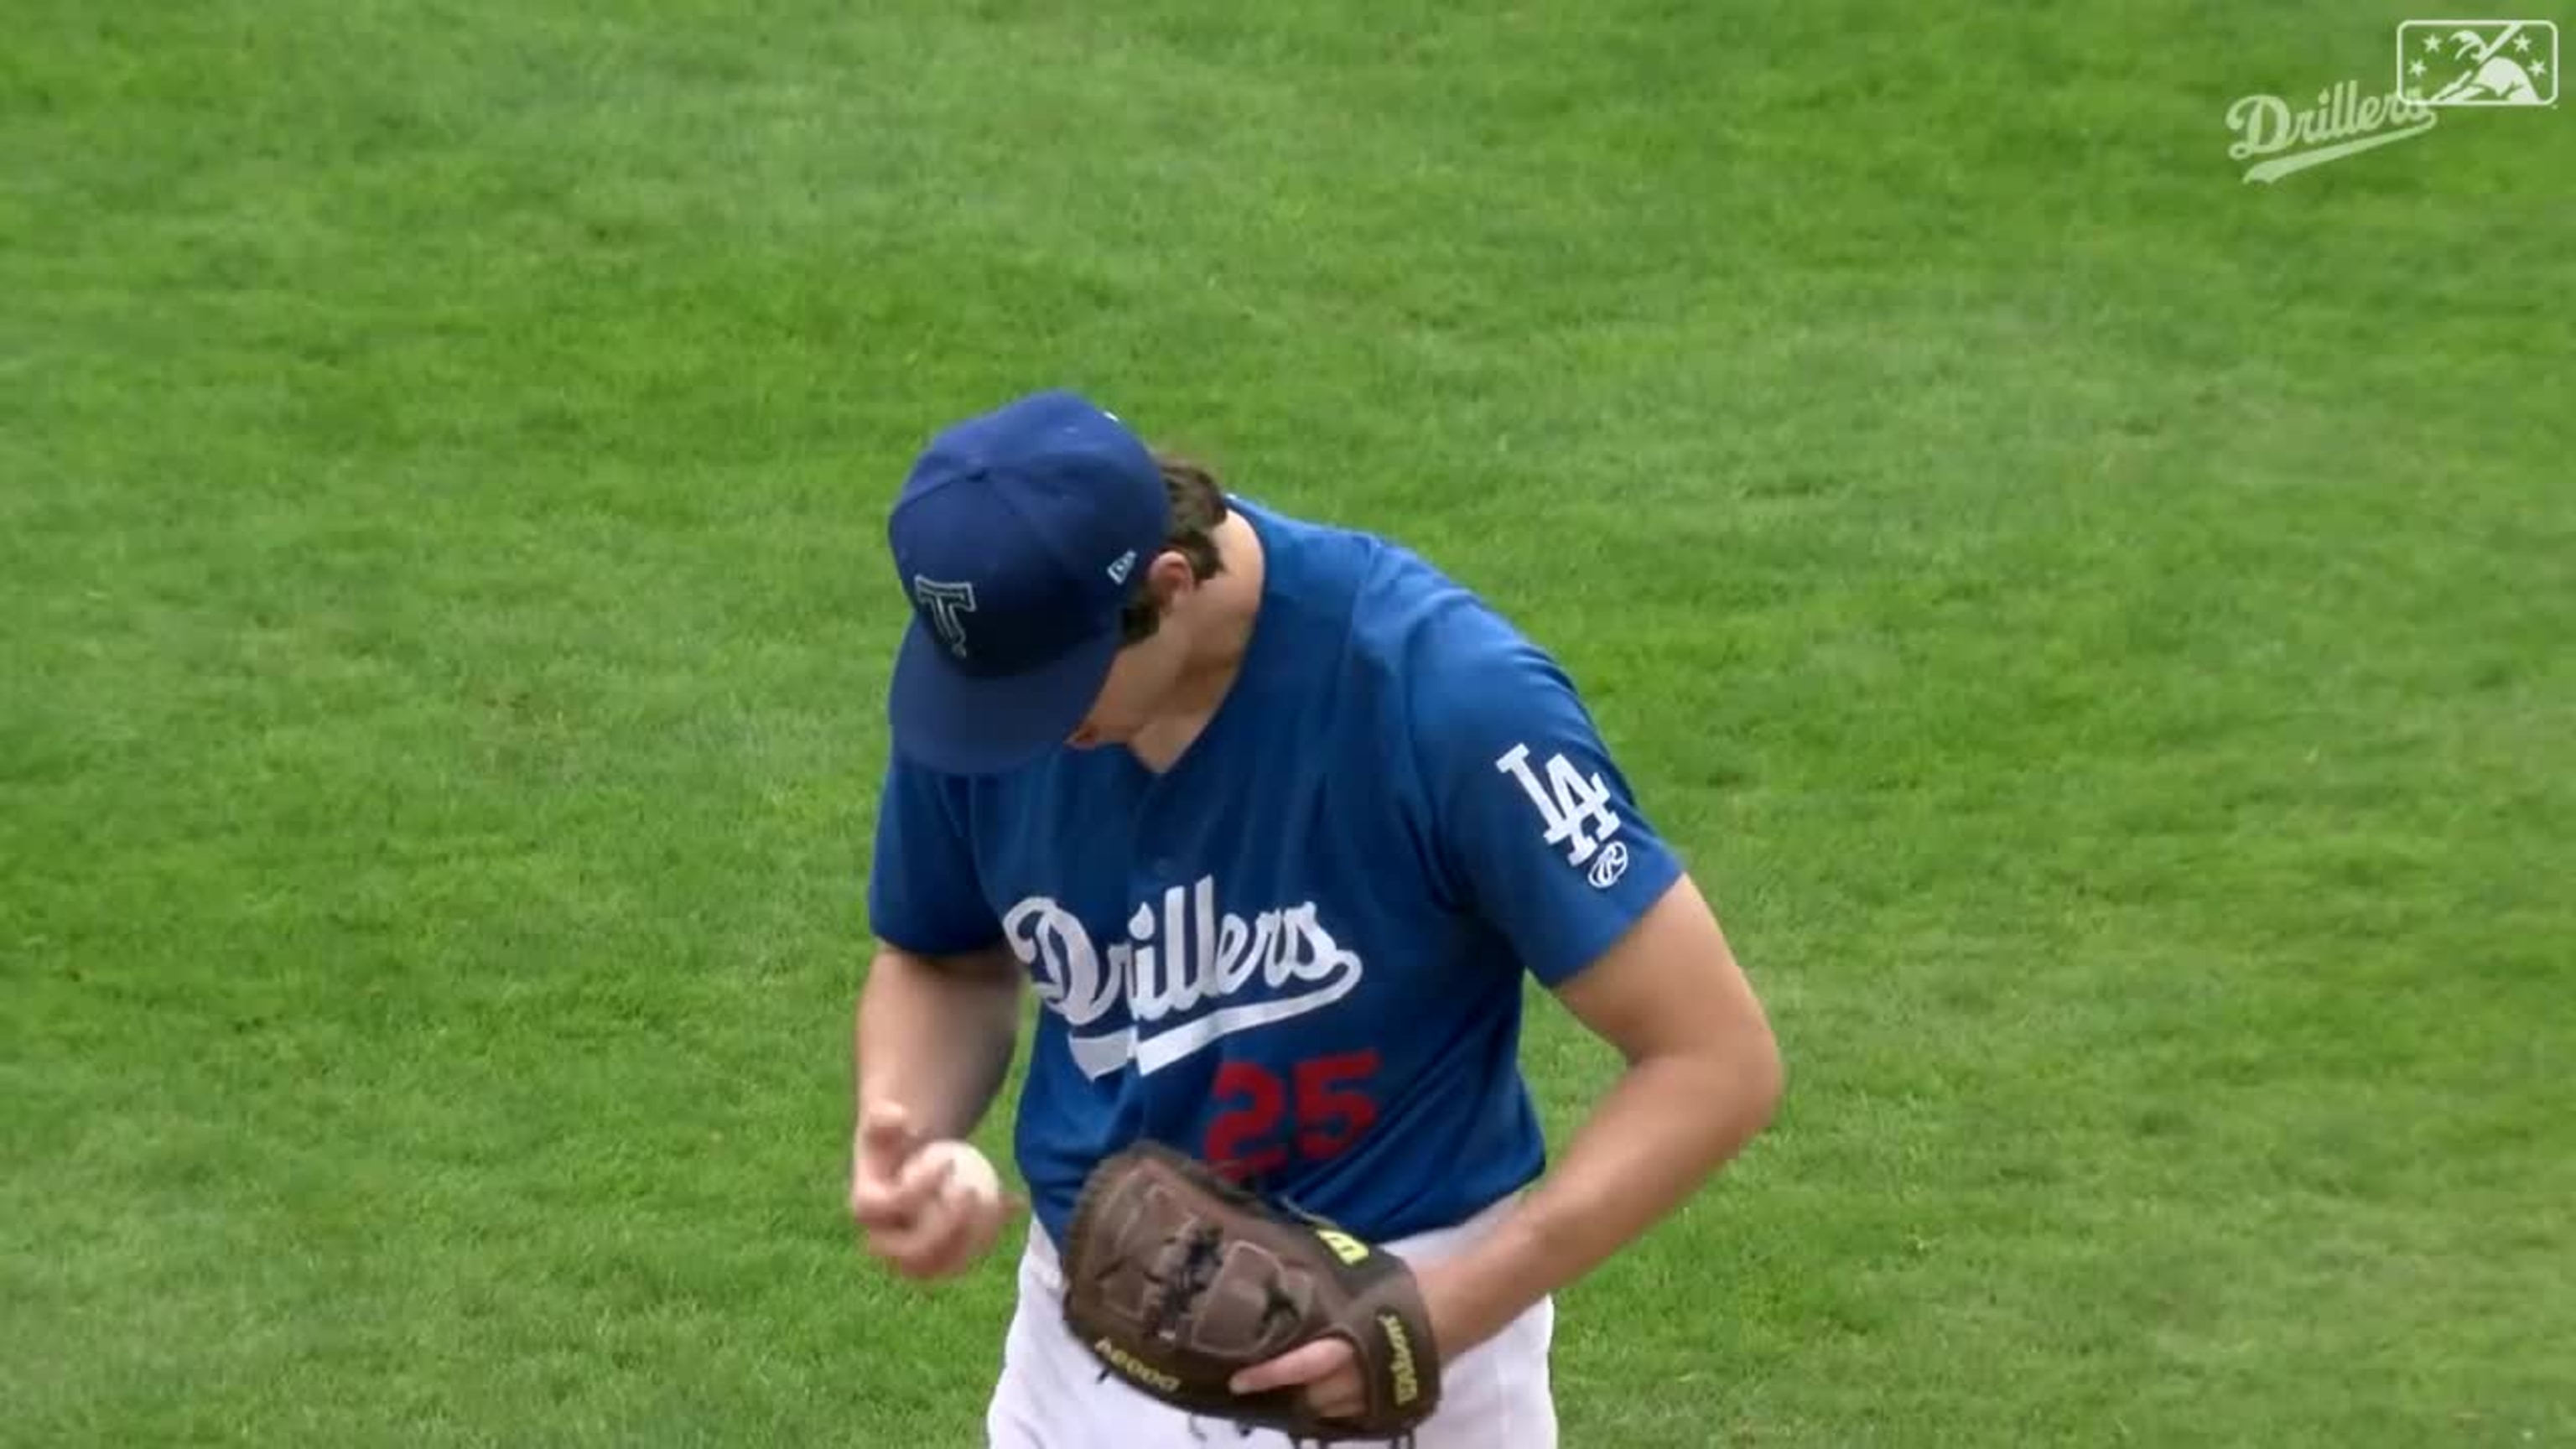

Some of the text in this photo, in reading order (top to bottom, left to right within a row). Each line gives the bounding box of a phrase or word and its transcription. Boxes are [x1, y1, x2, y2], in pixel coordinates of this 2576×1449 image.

[1495, 742, 1621, 867] LA
[1003, 874, 1363, 1083] Drillers
[1203, 1045, 1382, 1183] 25
